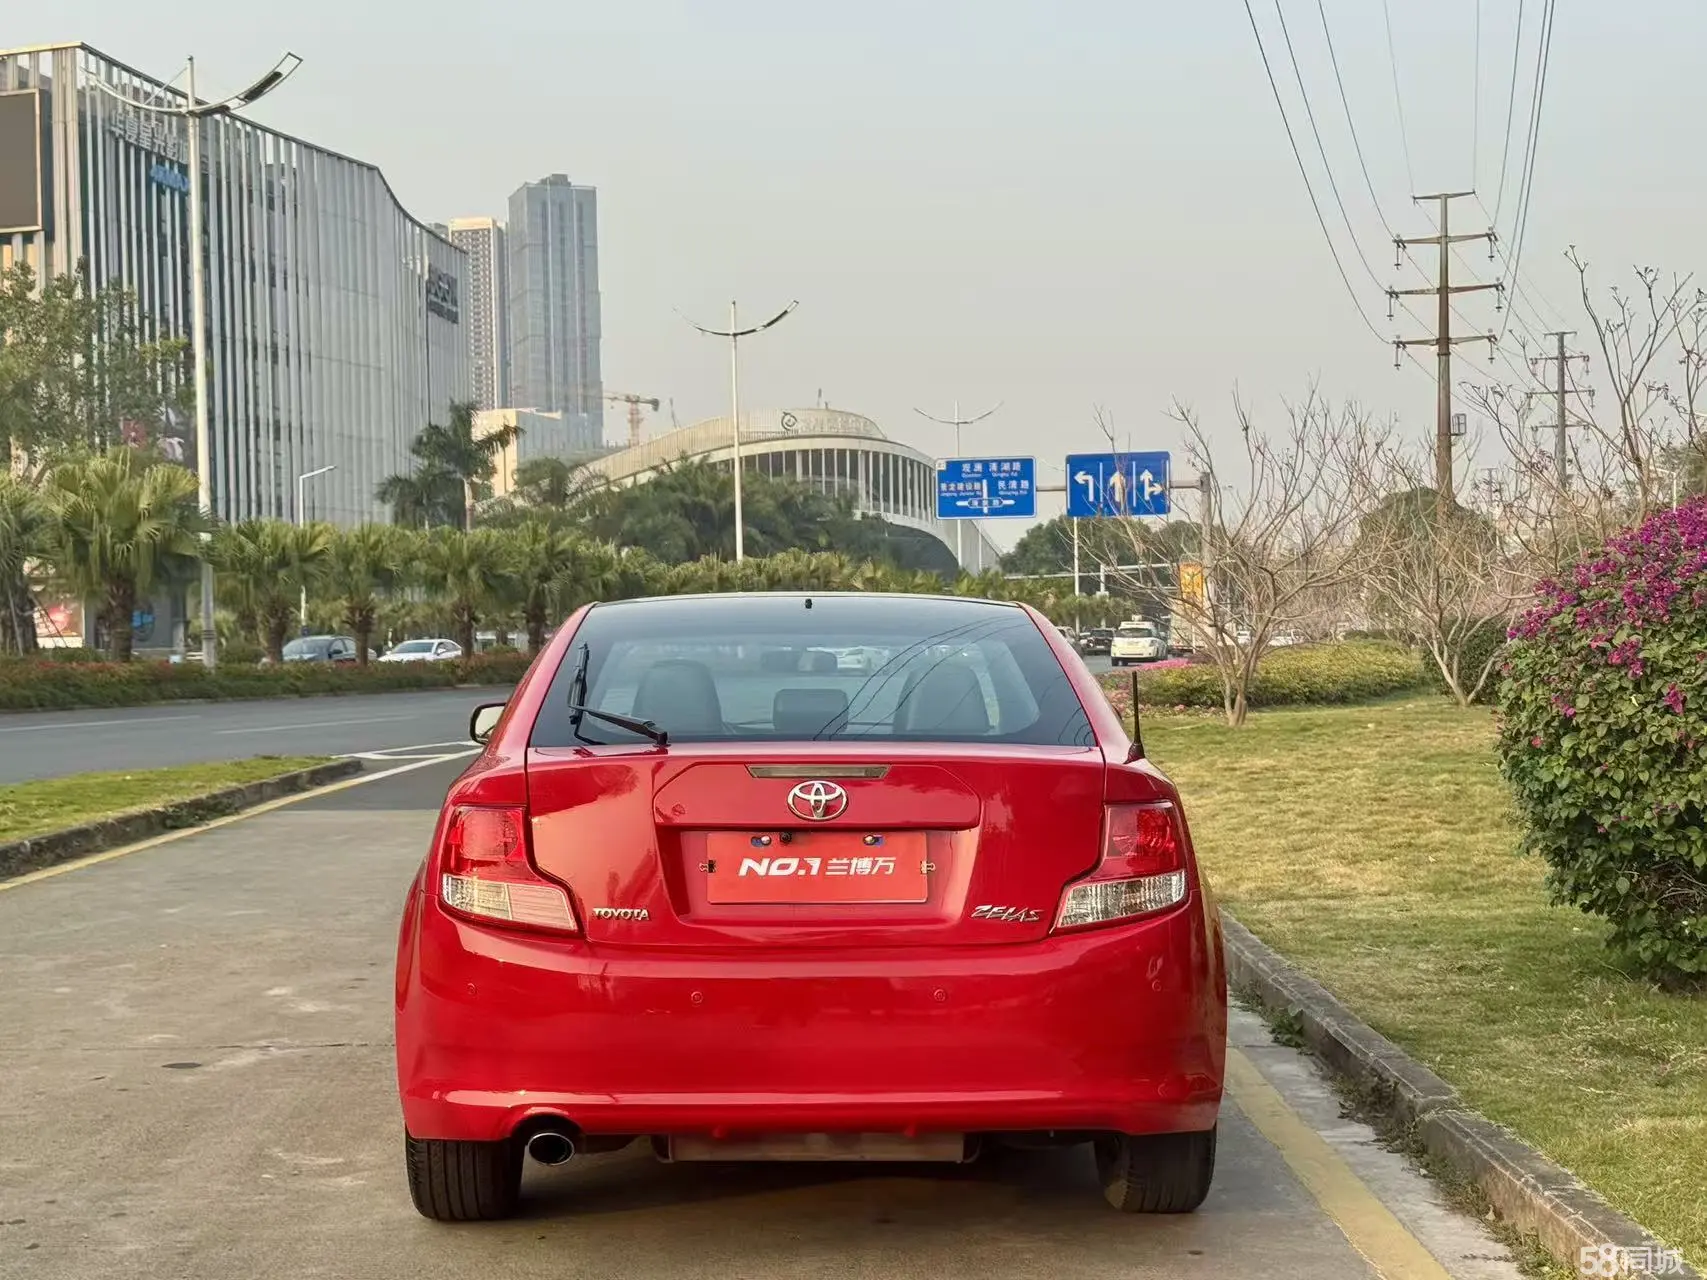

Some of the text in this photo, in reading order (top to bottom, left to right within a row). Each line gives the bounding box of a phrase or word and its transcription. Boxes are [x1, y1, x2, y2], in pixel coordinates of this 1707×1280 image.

[738, 857, 897, 876] NO.1 兰博万
[593, 907, 650, 921] TOYOTA
[971, 904, 1044, 922] ZELAS
